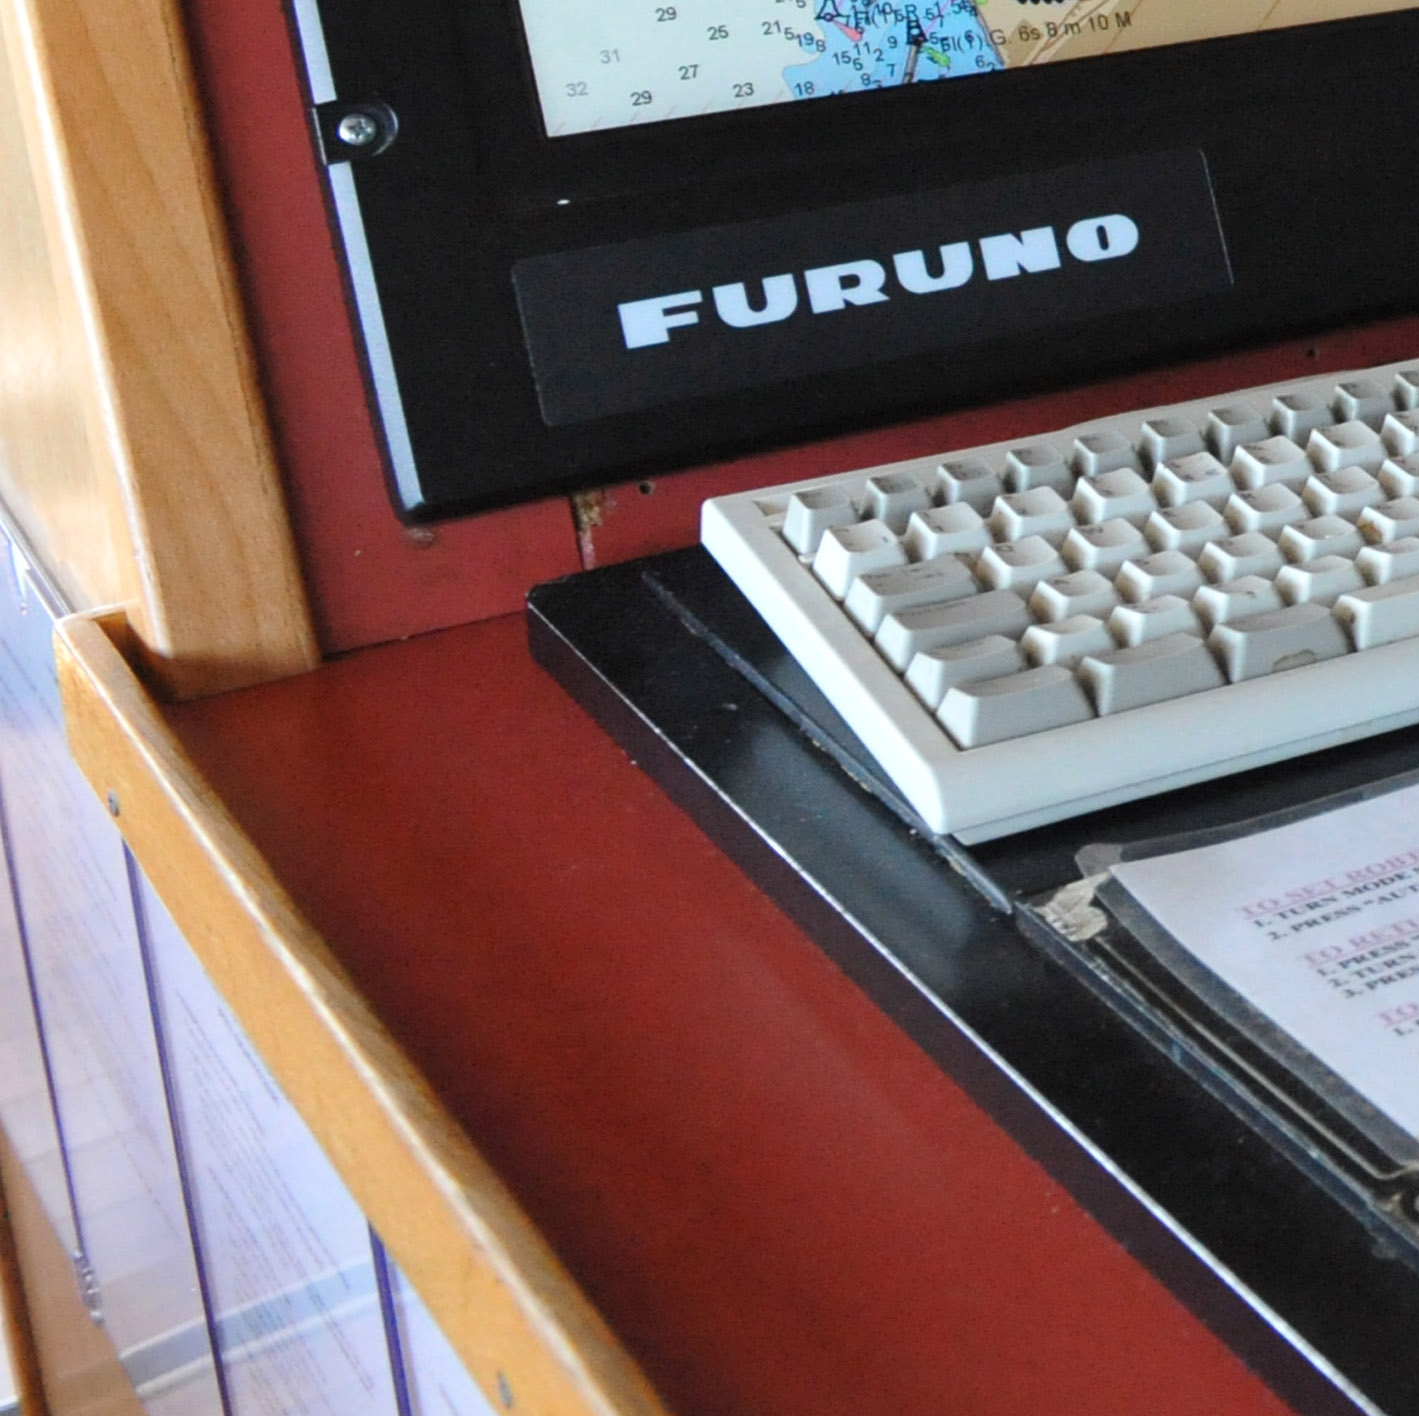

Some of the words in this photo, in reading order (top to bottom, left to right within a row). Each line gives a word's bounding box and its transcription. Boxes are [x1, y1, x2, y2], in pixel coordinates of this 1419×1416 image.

[616, 213, 1140, 350] FURUNO
[1276, 895, 1338, 921] TURN
[1340, 871, 1412, 898] MODE
[1290, 904, 1363, 935] PRESS
[1337, 939, 1411, 970] PRESS
[1353, 952, 1417, 979] TURN
